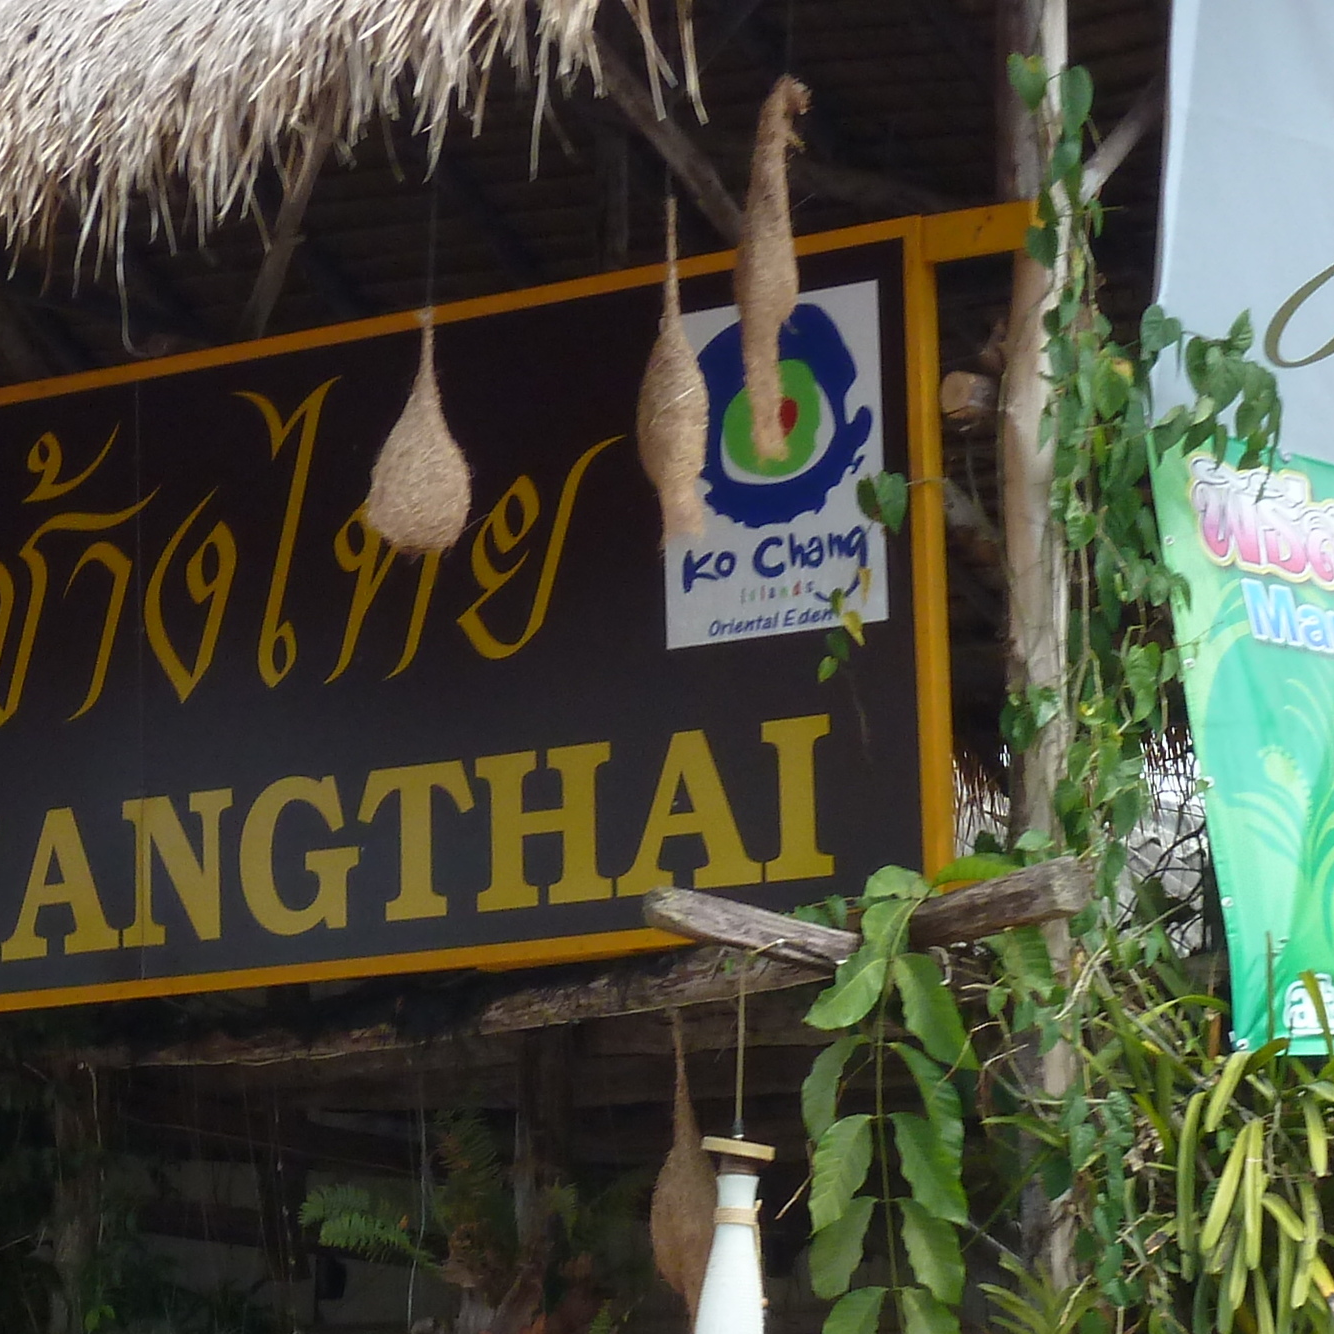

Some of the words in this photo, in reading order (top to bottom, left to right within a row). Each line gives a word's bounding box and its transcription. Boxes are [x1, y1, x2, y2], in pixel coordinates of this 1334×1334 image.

[682, 550, 736, 594] Ko
[753, 525, 869, 602] Chang
[708, 611, 779, 637] Oriental
[783, 607, 834, 626] Eden
